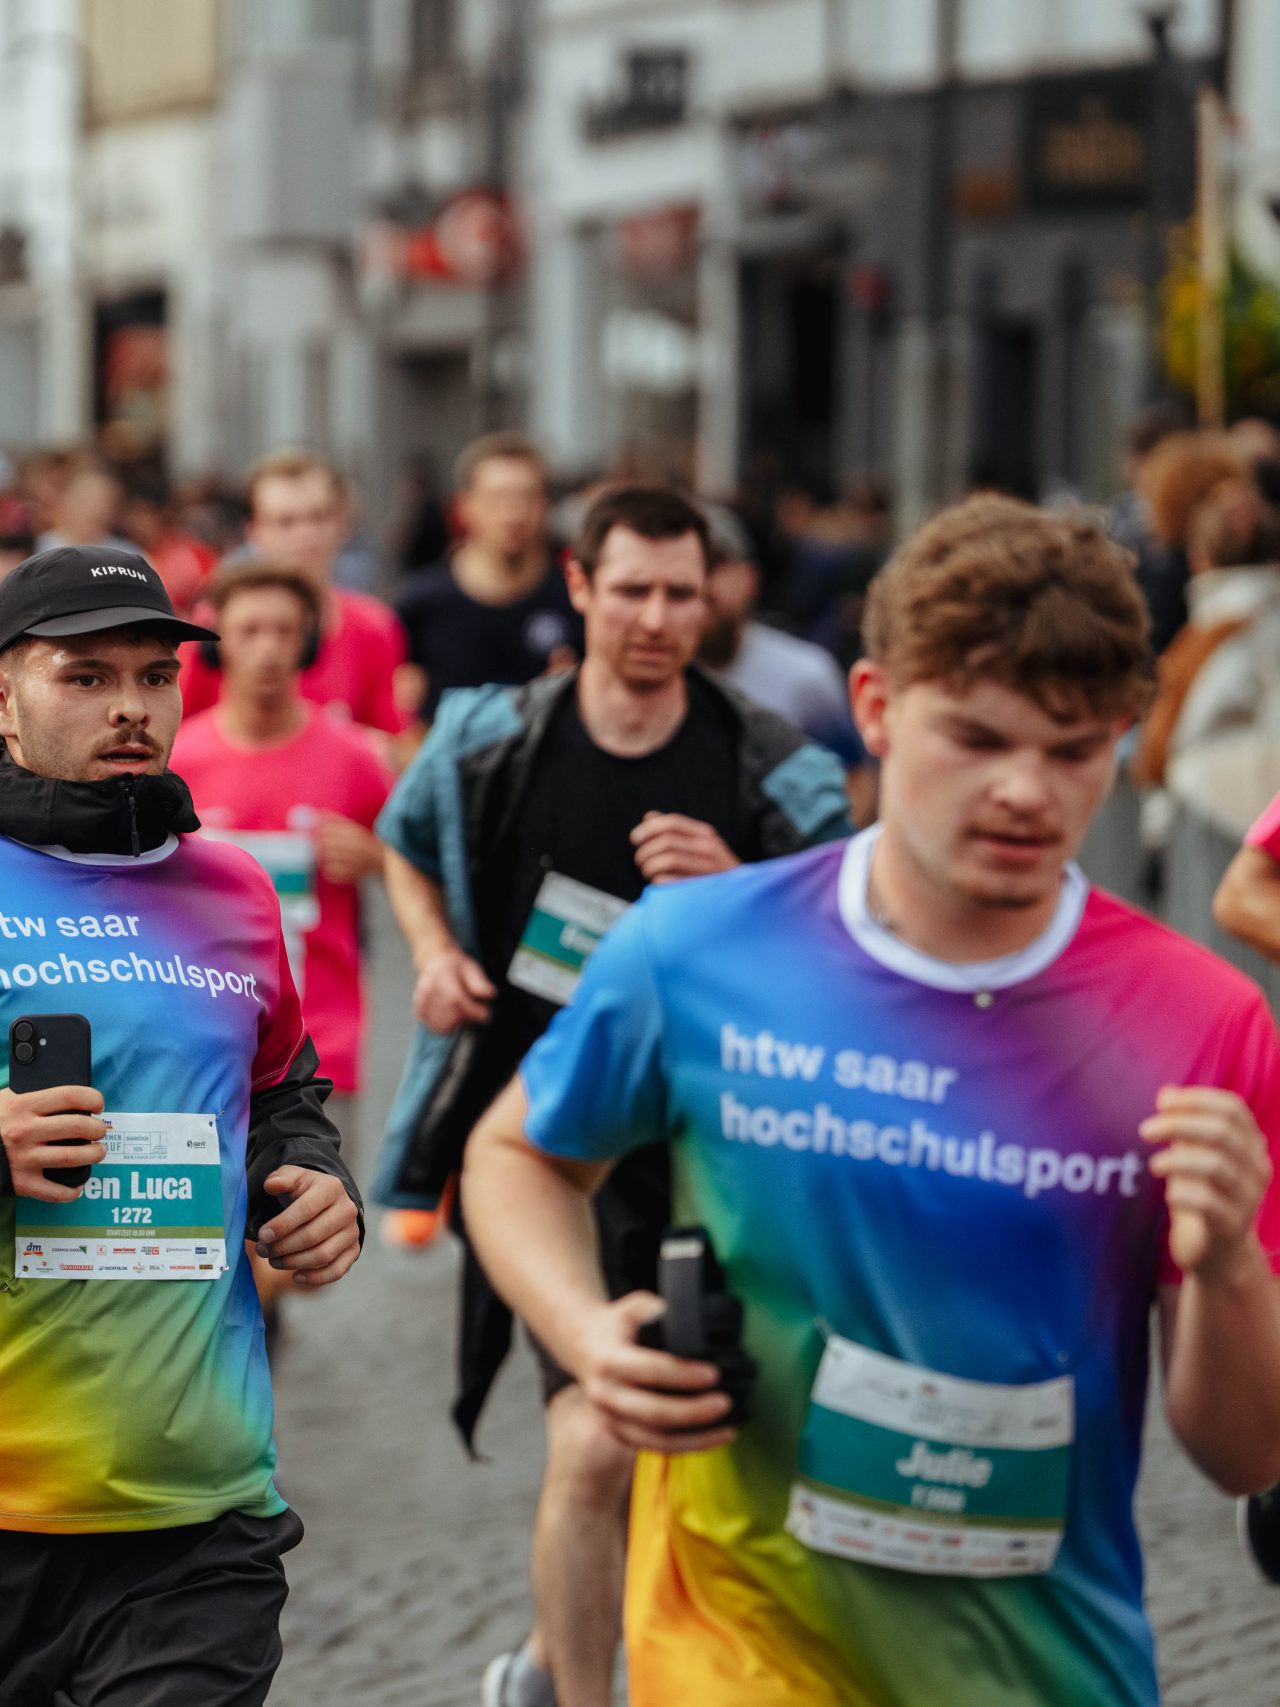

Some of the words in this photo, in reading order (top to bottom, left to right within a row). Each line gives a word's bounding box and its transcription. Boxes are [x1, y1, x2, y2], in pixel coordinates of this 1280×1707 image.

[90, 566, 147, 582] KIPRUN
[59, 914, 139, 938] saar
[721, 1023, 825, 1082] htw
[833, 1049, 959, 1105] saar
[720, 1091, 1143, 1199] hochschulsport
[79, 1176, 120, 1199] en
[130, 1171, 193, 1199] Luca
[111, 1207, 152, 1224] 1272
[26, 1243, 41, 1251] dm
